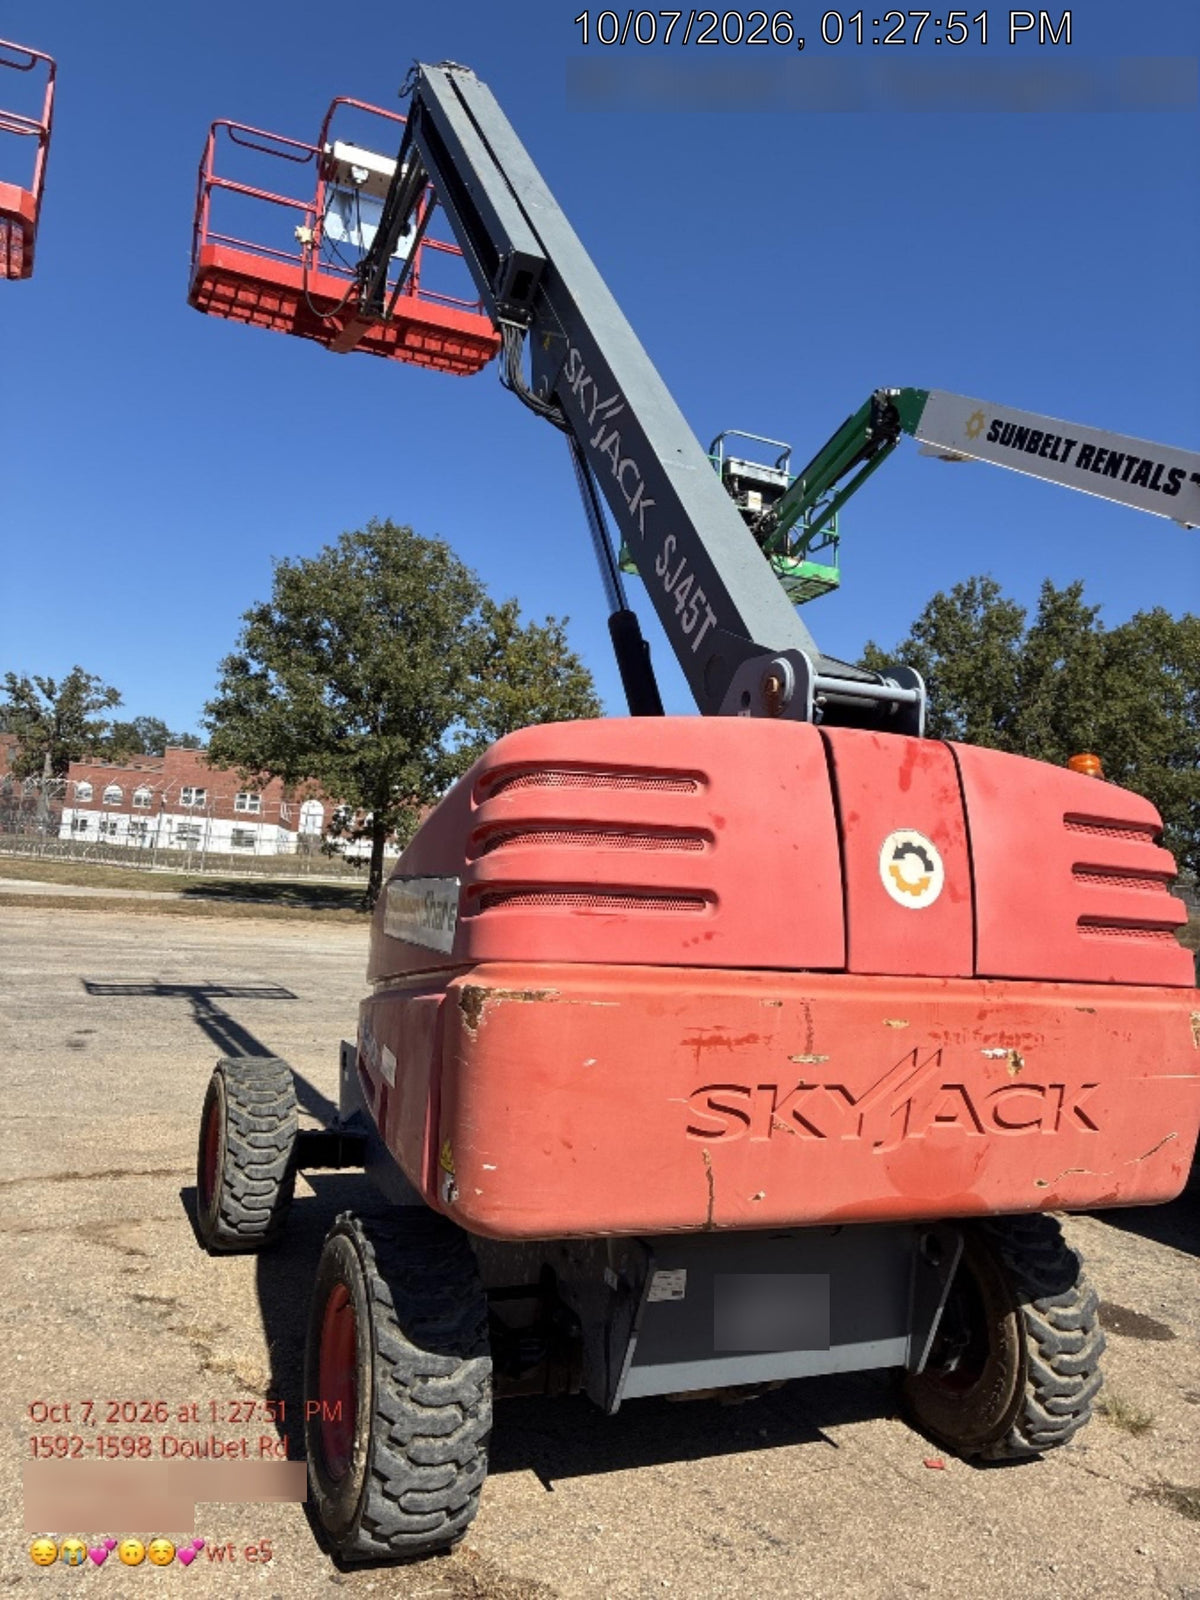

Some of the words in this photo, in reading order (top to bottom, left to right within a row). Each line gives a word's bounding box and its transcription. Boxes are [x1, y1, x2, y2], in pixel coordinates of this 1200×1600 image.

[564, 347, 656, 540] SKYJACK
[655, 535, 717, 653] SJ45T
[986, 418, 1077, 464] SUNBELT
[1075, 443, 1187, 497] RENTALS
[685, 1047, 1100, 1154] SKYJACK
